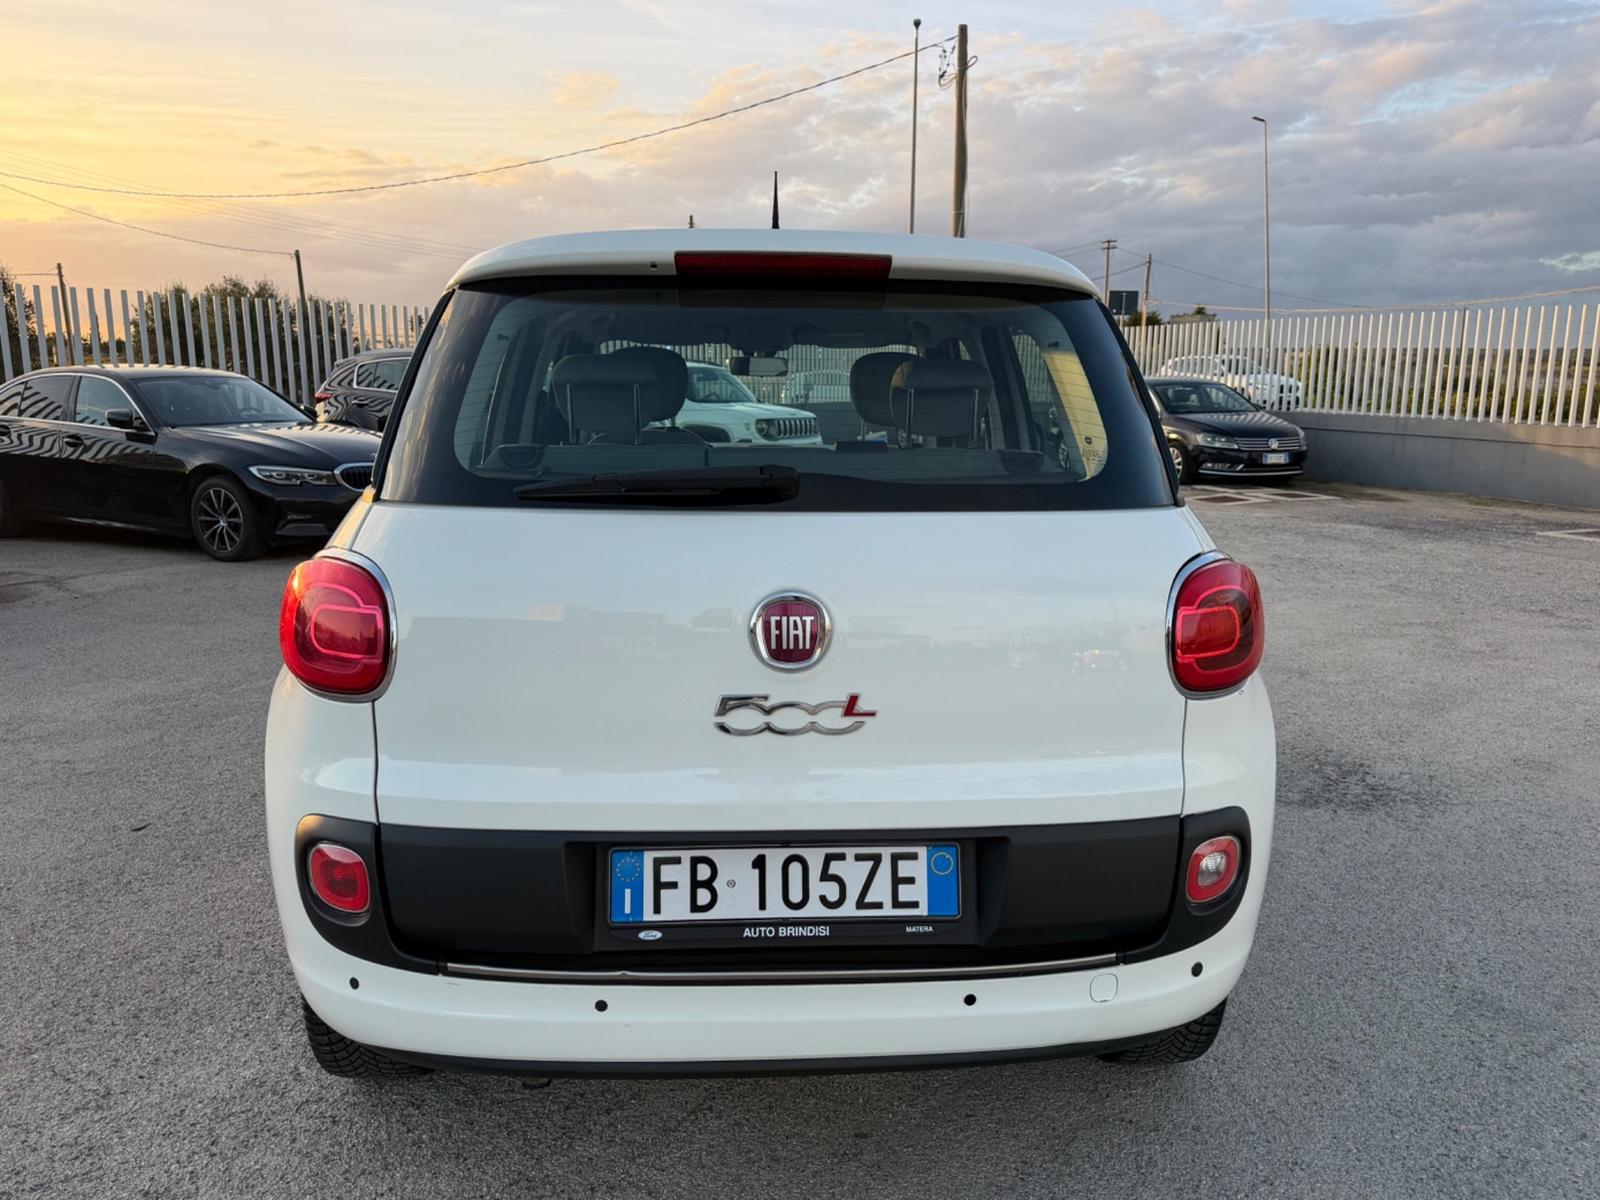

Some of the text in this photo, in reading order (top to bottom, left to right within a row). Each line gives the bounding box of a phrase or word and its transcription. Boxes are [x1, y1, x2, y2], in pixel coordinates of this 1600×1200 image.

[770, 616, 815, 650] FIAT
[714, 692, 878, 736] 500L
[653, 852, 920, 915] FB 105ZE
[743, 926, 830, 938] AUTO BRINDISI
[905, 925, 934, 933] MATERA
